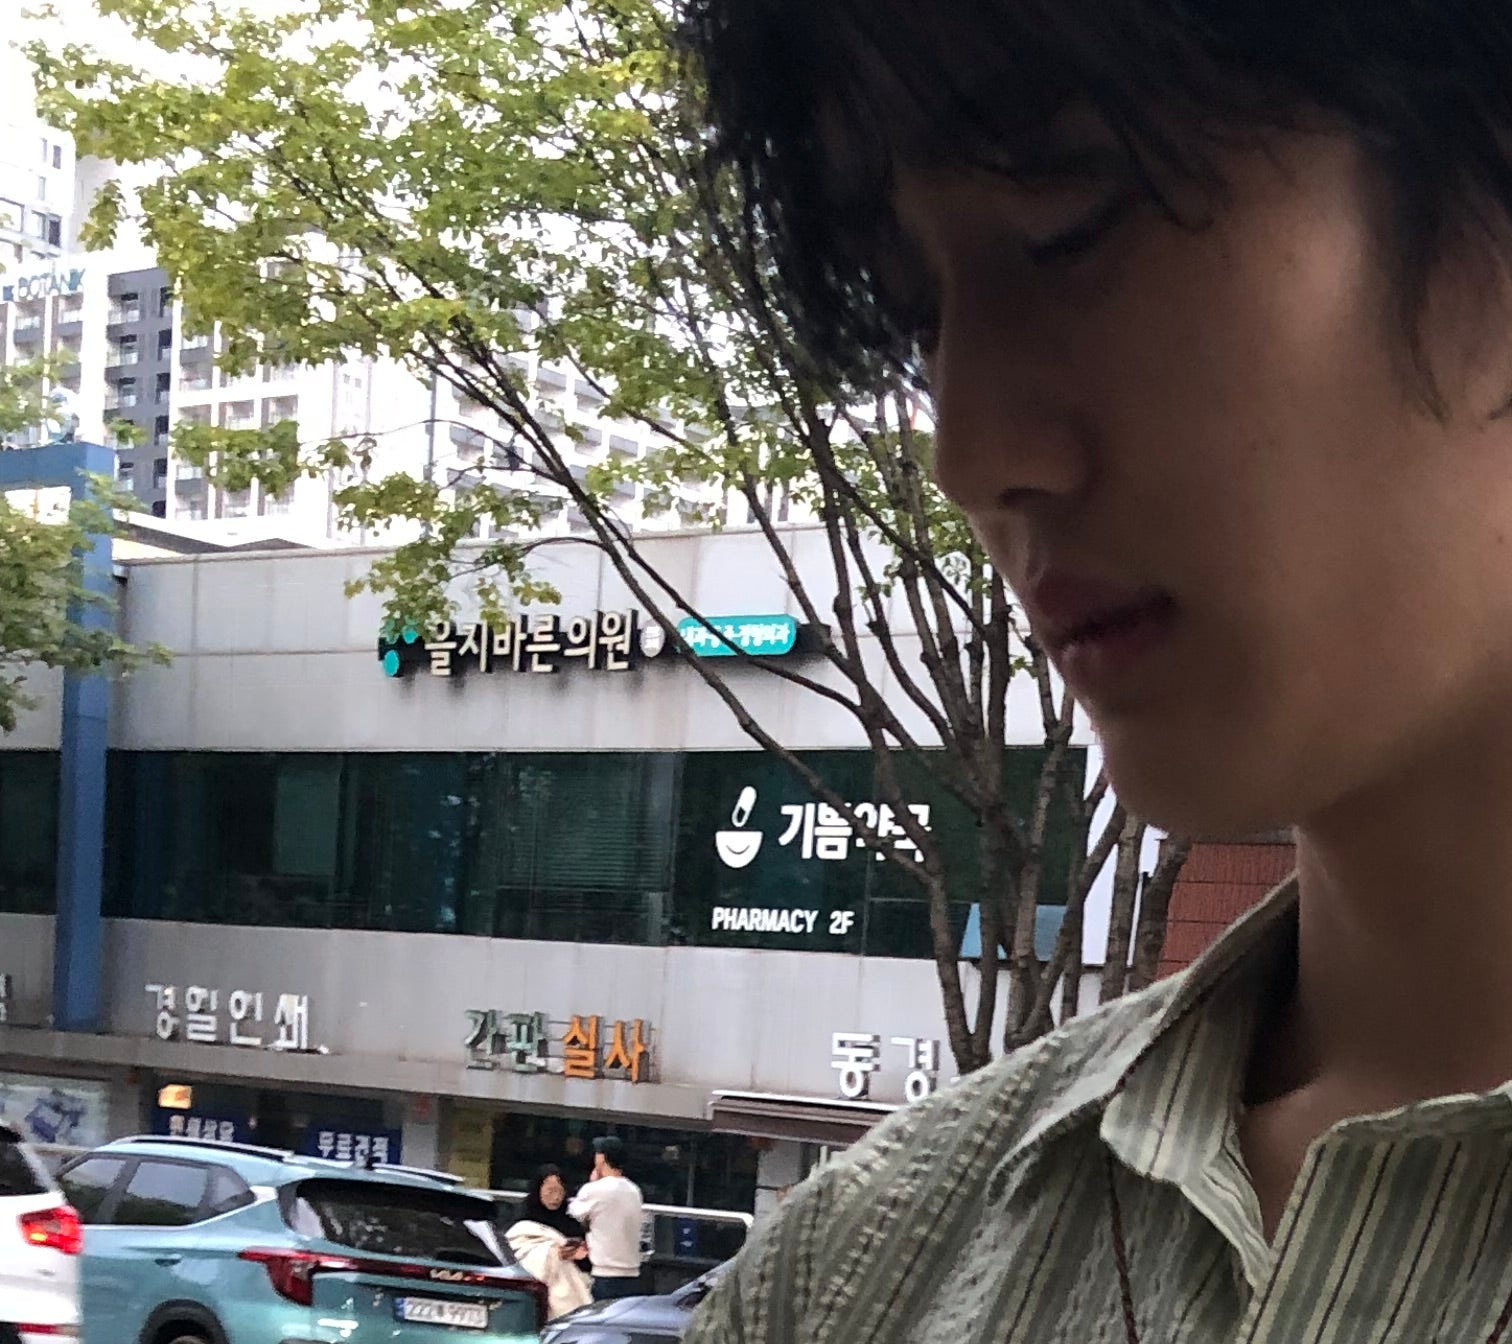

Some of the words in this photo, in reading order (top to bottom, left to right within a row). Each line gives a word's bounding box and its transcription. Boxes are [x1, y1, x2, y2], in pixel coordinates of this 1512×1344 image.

[711, 906, 819, 933] PHARMACY
[829, 910, 855, 934] 2F
[145, 983, 308, 1050] 경일인쇄
[563, 1014, 648, 1083] 실사
[831, 1032, 961, 1104] 동경
